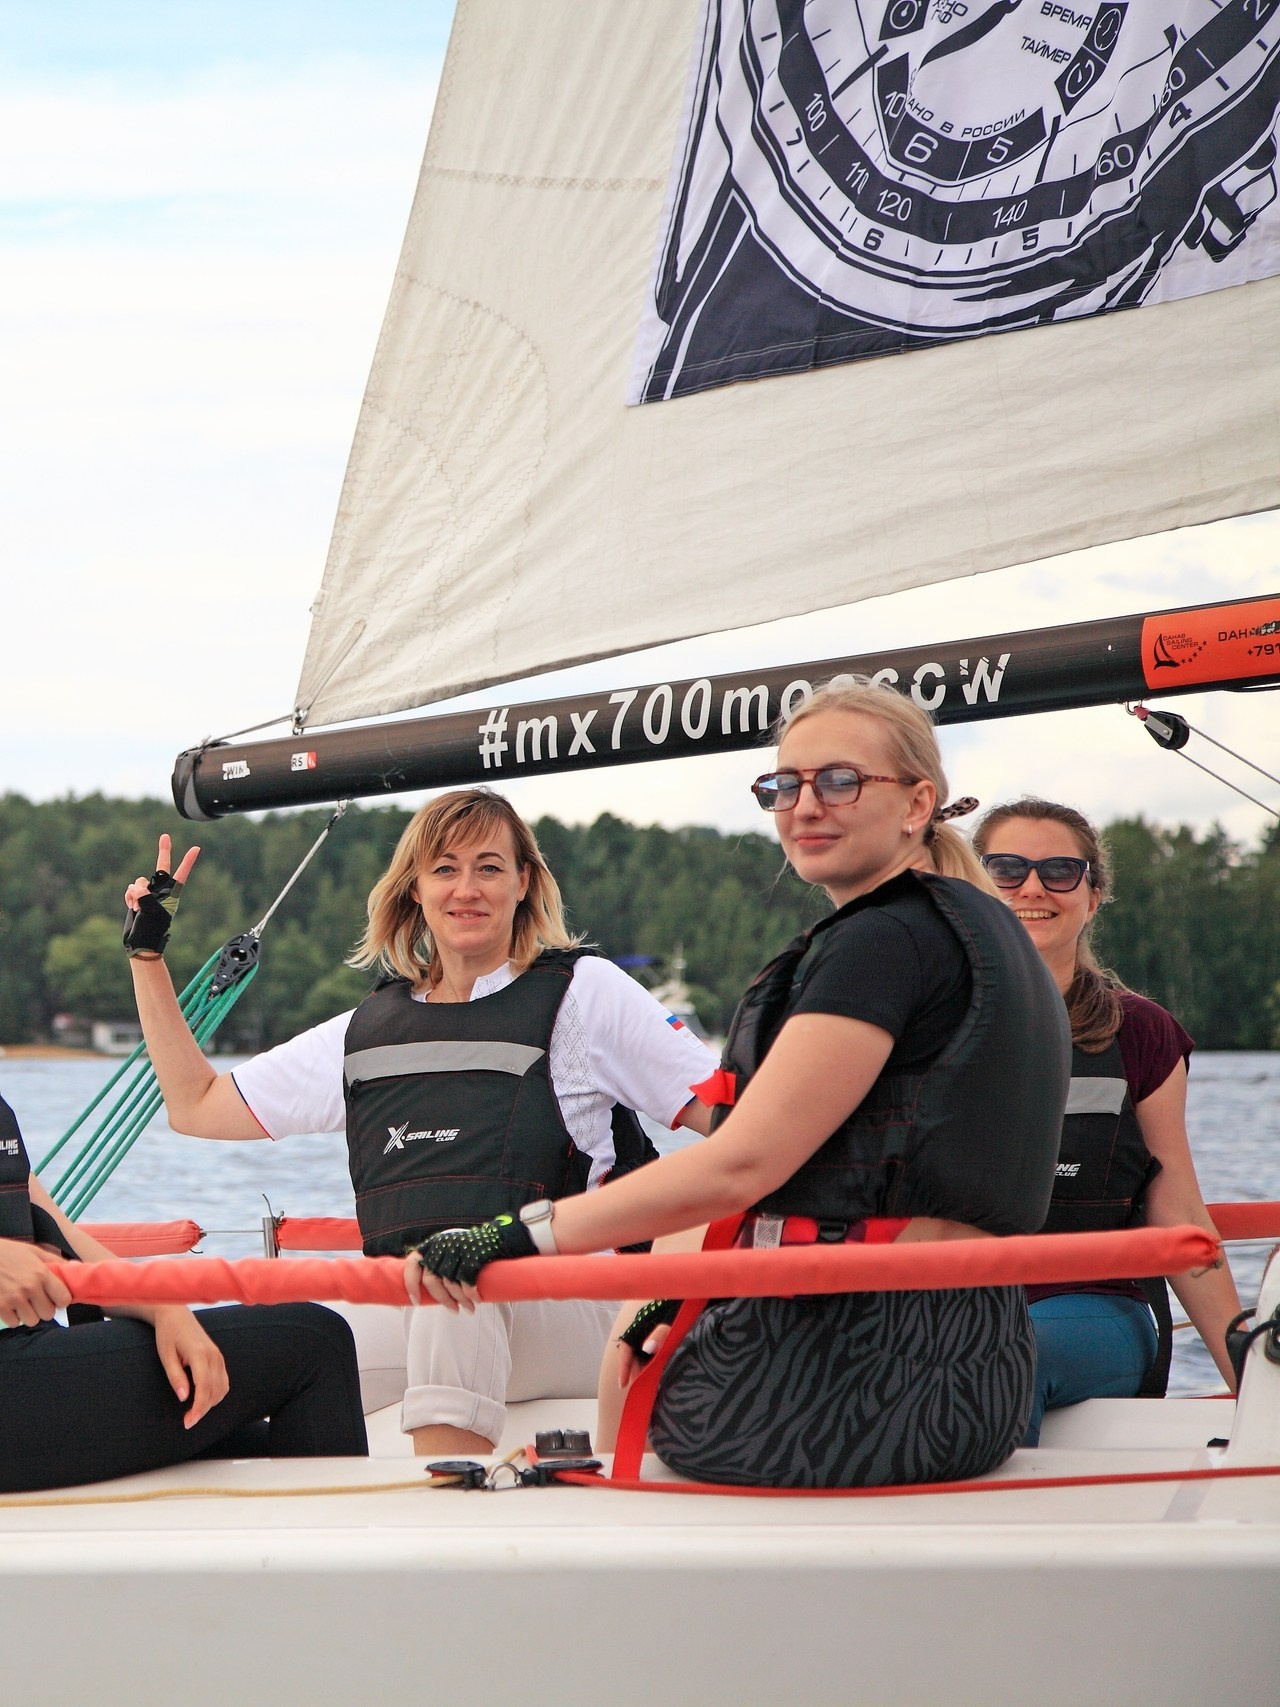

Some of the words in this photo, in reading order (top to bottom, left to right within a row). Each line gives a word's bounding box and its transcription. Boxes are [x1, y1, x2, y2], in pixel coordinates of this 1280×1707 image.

[1040, 1, 1092, 31] ВРЕМЯ
[1022, 36, 1071, 64] ТАЙМЕР
[805, 93, 826, 132] 100
[940, 121, 954, 134] В
[961, 109, 1025, 138] РОССИИ
[1169, 101, 1193, 129] 4
[904, 132, 938, 163] 6
[987, 137, 1013, 163] 5
[876, 189, 912, 221] 120
[992, 200, 1028, 229] 140
[863, 228, 884, 250] 6
[1022, 227, 1039, 250] 5
[405, 1129, 460, 1142] SAILING
